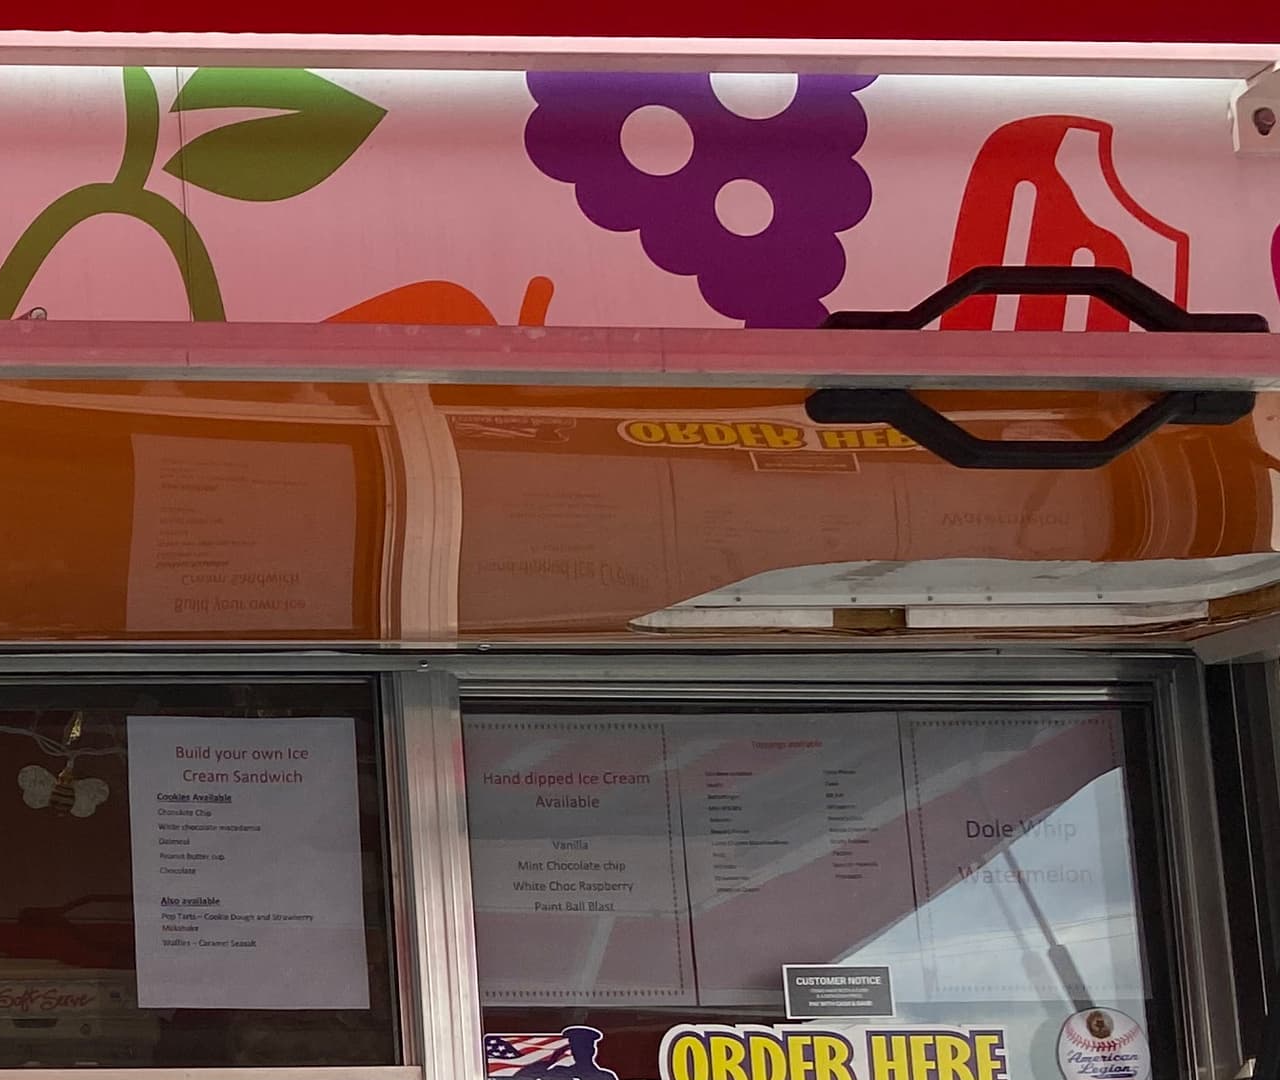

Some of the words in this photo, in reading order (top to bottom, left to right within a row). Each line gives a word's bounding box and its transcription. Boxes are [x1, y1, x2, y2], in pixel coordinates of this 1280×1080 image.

[175, 746, 210, 759] Build
[215, 748, 246, 763] your
[252, 749, 283, 760] own
[288, 748, 309, 760] Ice
[183, 769, 229, 783] Cream
[233, 769, 303, 784] Sandwich
[483, 773, 521, 785] Hand
[524, 772, 574, 788] dipped
[578, 772, 600, 785] Ice
[603, 772, 651, 785] Cream
[156, 792, 190, 802] Cookies
[192, 792, 232, 803] Available
[535, 795, 600, 809] Available
[966, 819, 1013, 838] Dole
[1019, 818, 1077, 841] Whip
[552, 840, 589, 850] Vanilla
[518, 861, 543, 871] Mint
[546, 860, 601, 871] Chocolate
[603, 860, 626, 873] chip
[958, 864, 1093, 885] Watermelon
[513, 881, 547, 891] White
[549, 881, 576, 891] Choc
[579, 881, 633, 893] Raspberry
[161, 897, 180, 906] Also
[182, 897, 220, 907] available
[535, 901, 563, 911] Paint
[566, 901, 585, 911] Ball
[588, 901, 616, 911] Blast
[161, 913, 176, 922] Pop
[256, 913, 270, 921] and
[795, 976, 846, 986] CUSTOMER
[847, 975, 882, 986] NOTICE
[40, 987, 95, 1010] Serve
[1067, 1051, 1139, 1064] American
[1078, 1063, 1134, 1077] Legion
